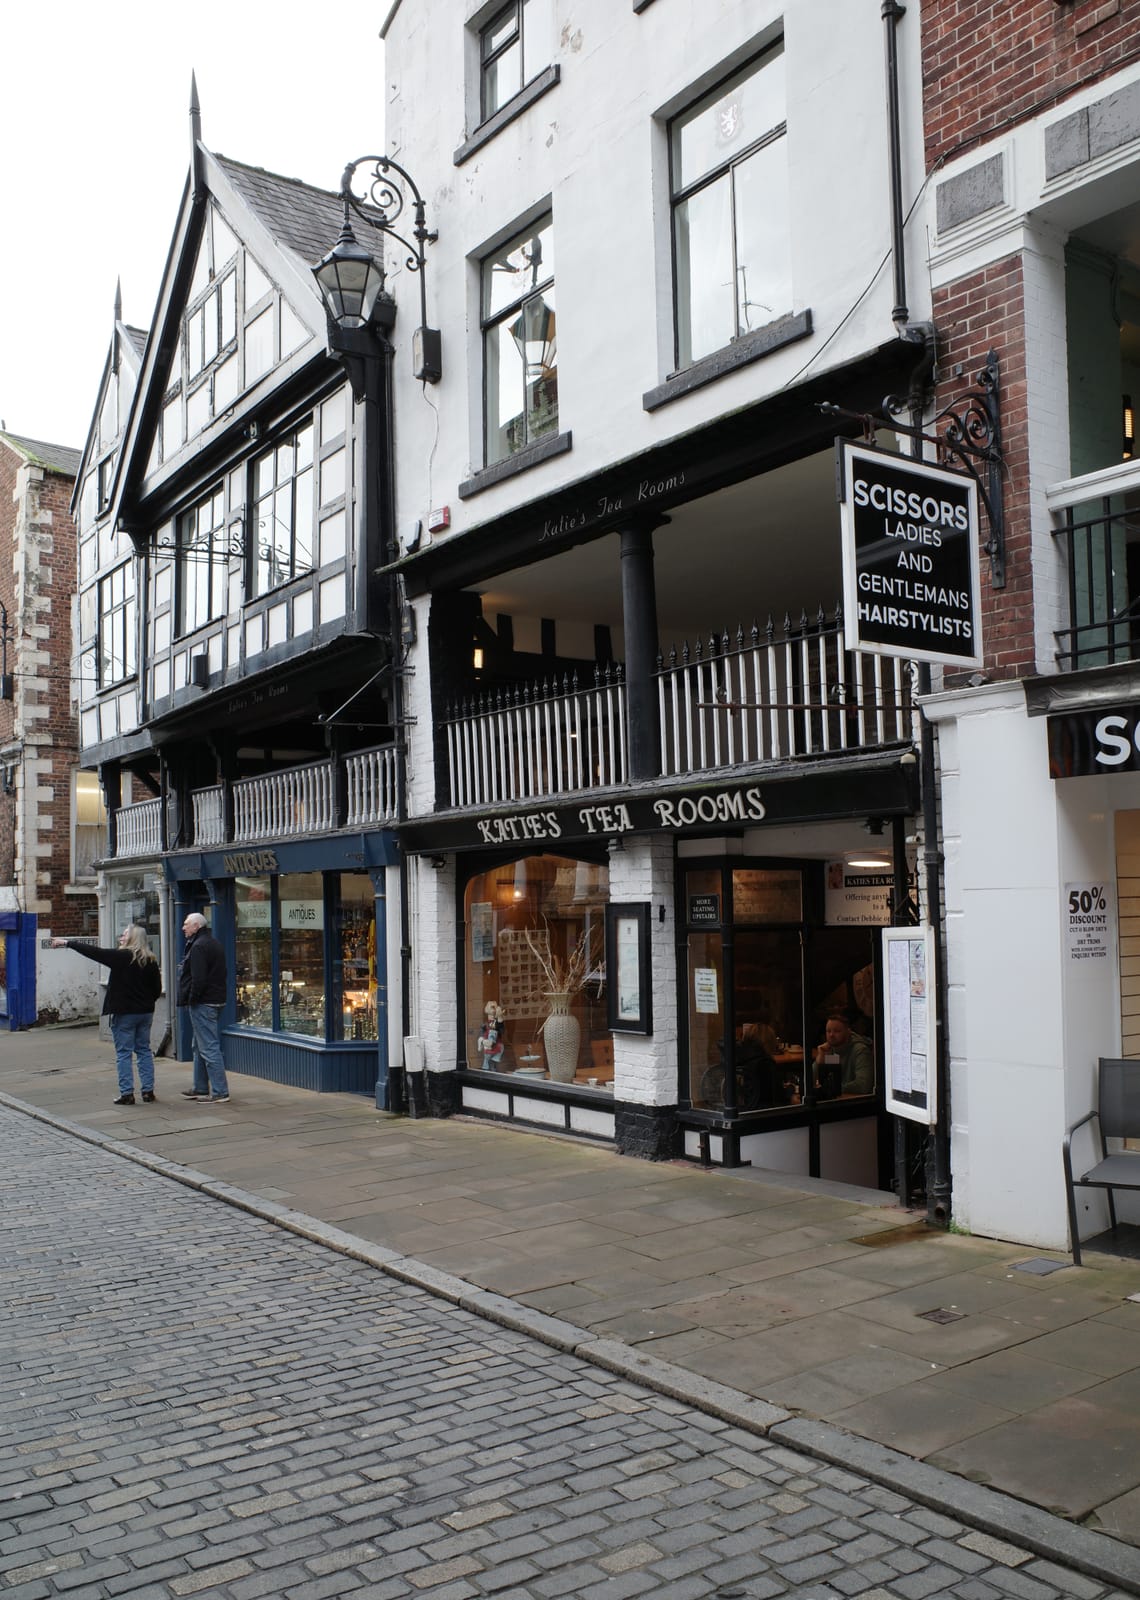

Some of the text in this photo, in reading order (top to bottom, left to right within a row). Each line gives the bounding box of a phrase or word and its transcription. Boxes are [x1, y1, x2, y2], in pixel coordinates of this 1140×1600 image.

[538, 471, 686, 542] Katie's Tea Rooms
[854, 479, 968, 531] SCISSORS
[884, 517, 942, 548] LADIES
[896, 551, 933, 573] AND
[858, 572, 969, 610] GENTLEMANS
[857, 602, 972, 639] HAIRSTYLISTS
[1095, 715, 1140, 766] S
[477, 787, 767, 843] KATIE'S TEA ROOMS
[223, 849, 278, 874] ANTIQUES
[872, 876, 885, 885] TEA
[845, 893, 871, 903] Offering
[1069, 886, 1106, 914] 50%
[288, 908, 316, 920] ANTIQUES
[836, 914, 860, 922] Contact
[861, 913, 882, 922] Debbie
[1069, 915, 1107, 925] DISCOUNT
